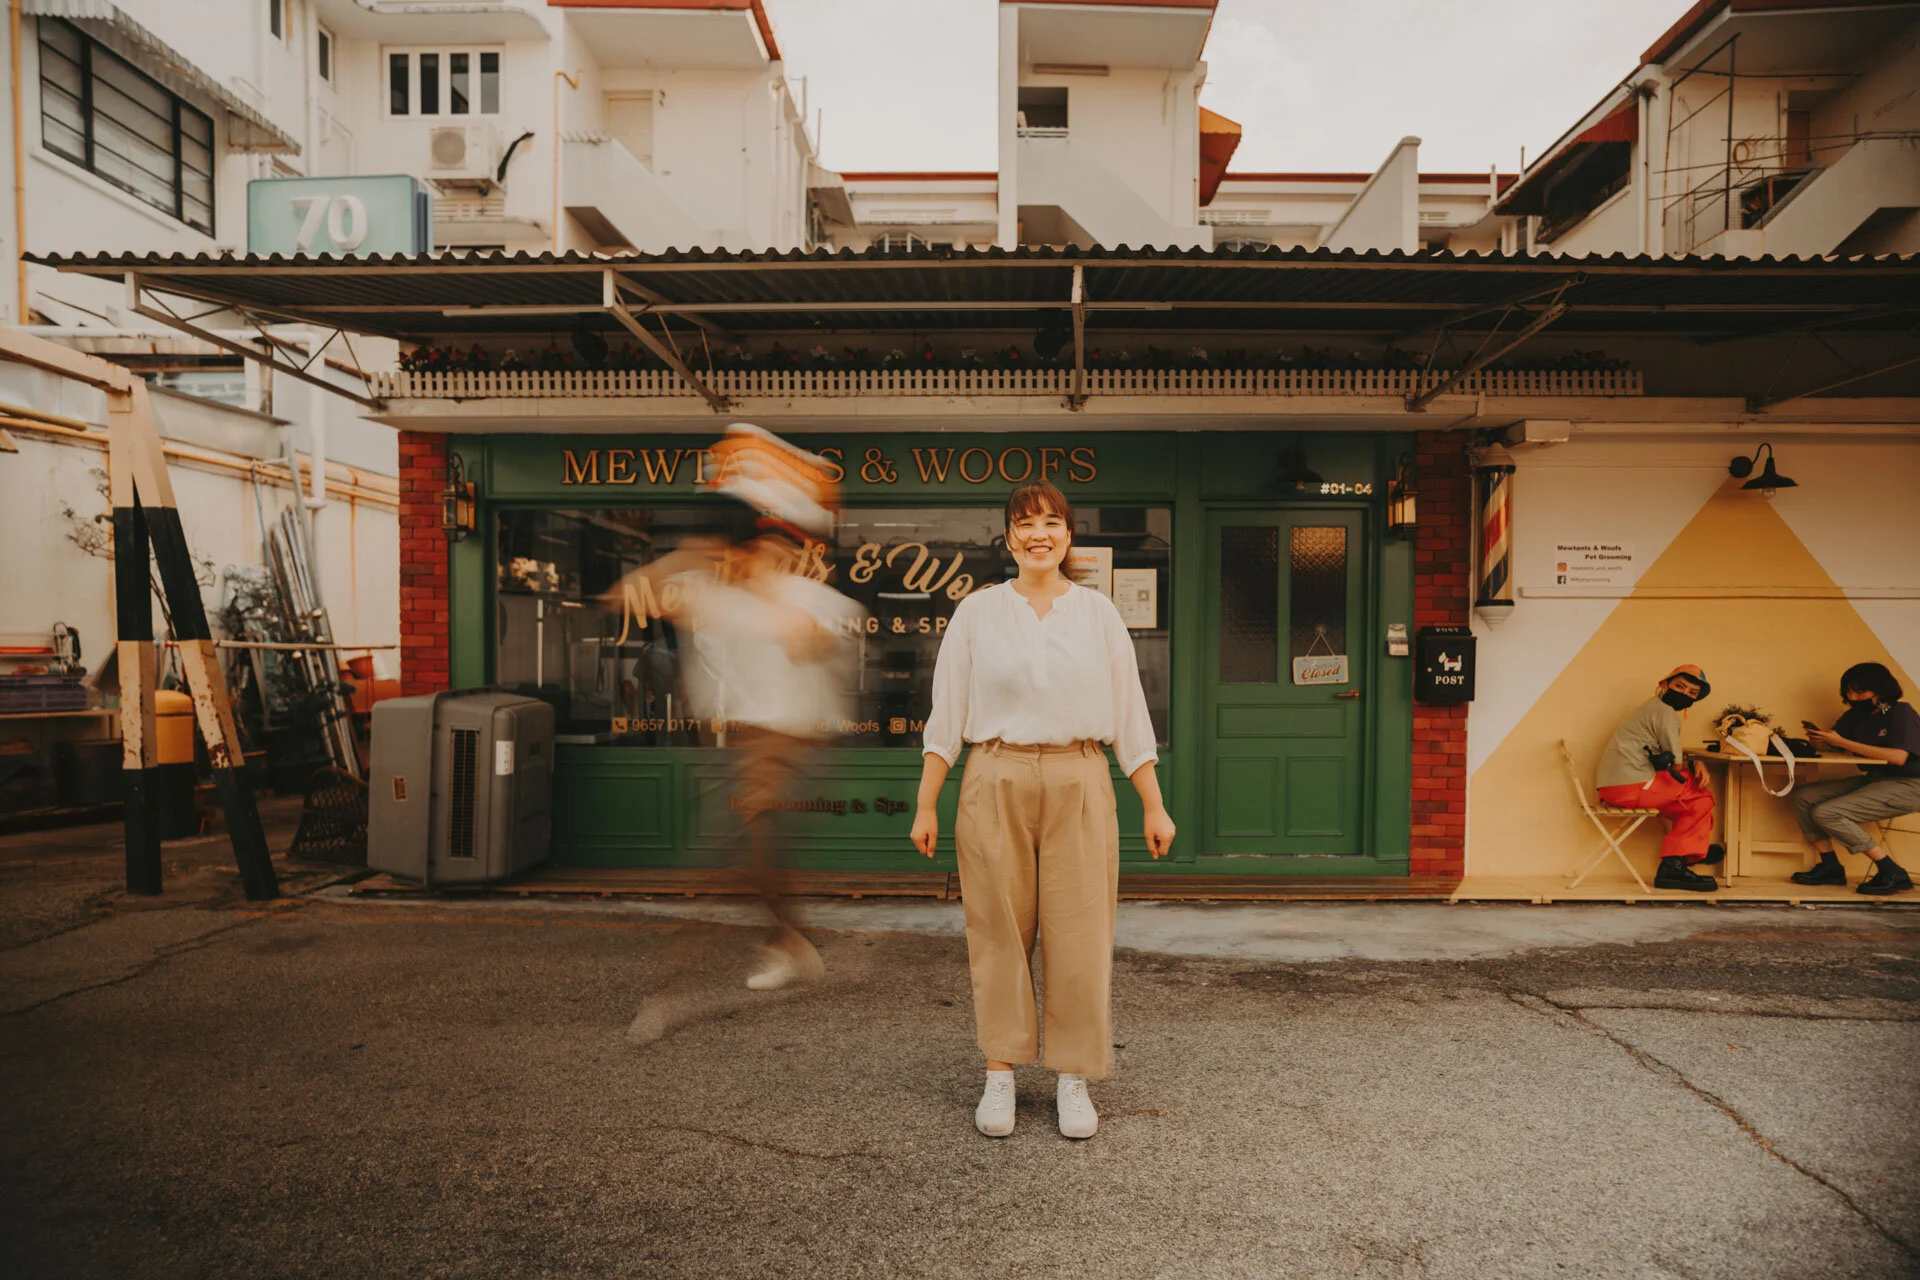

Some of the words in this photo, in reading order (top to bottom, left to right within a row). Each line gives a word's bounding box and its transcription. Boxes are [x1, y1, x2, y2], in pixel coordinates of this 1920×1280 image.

[291, 194, 367, 252] 70
[561, 448, 844, 484] MEWTAS
[860, 448, 898, 483] &
[911, 447, 1097, 483] WOOFS
[1320, 482, 1373, 495] #01-04
[850, 542, 882, 583] &
[891, 617, 906, 634] &
[1301, 664, 1341, 680] Closed
[1435, 675, 1465, 685] POST
[631, 718, 665, 732] 9657
[669, 718, 701, 732] 0171
[837, 719, 880, 733] Woofs
[873, 796, 909, 816] Spa
